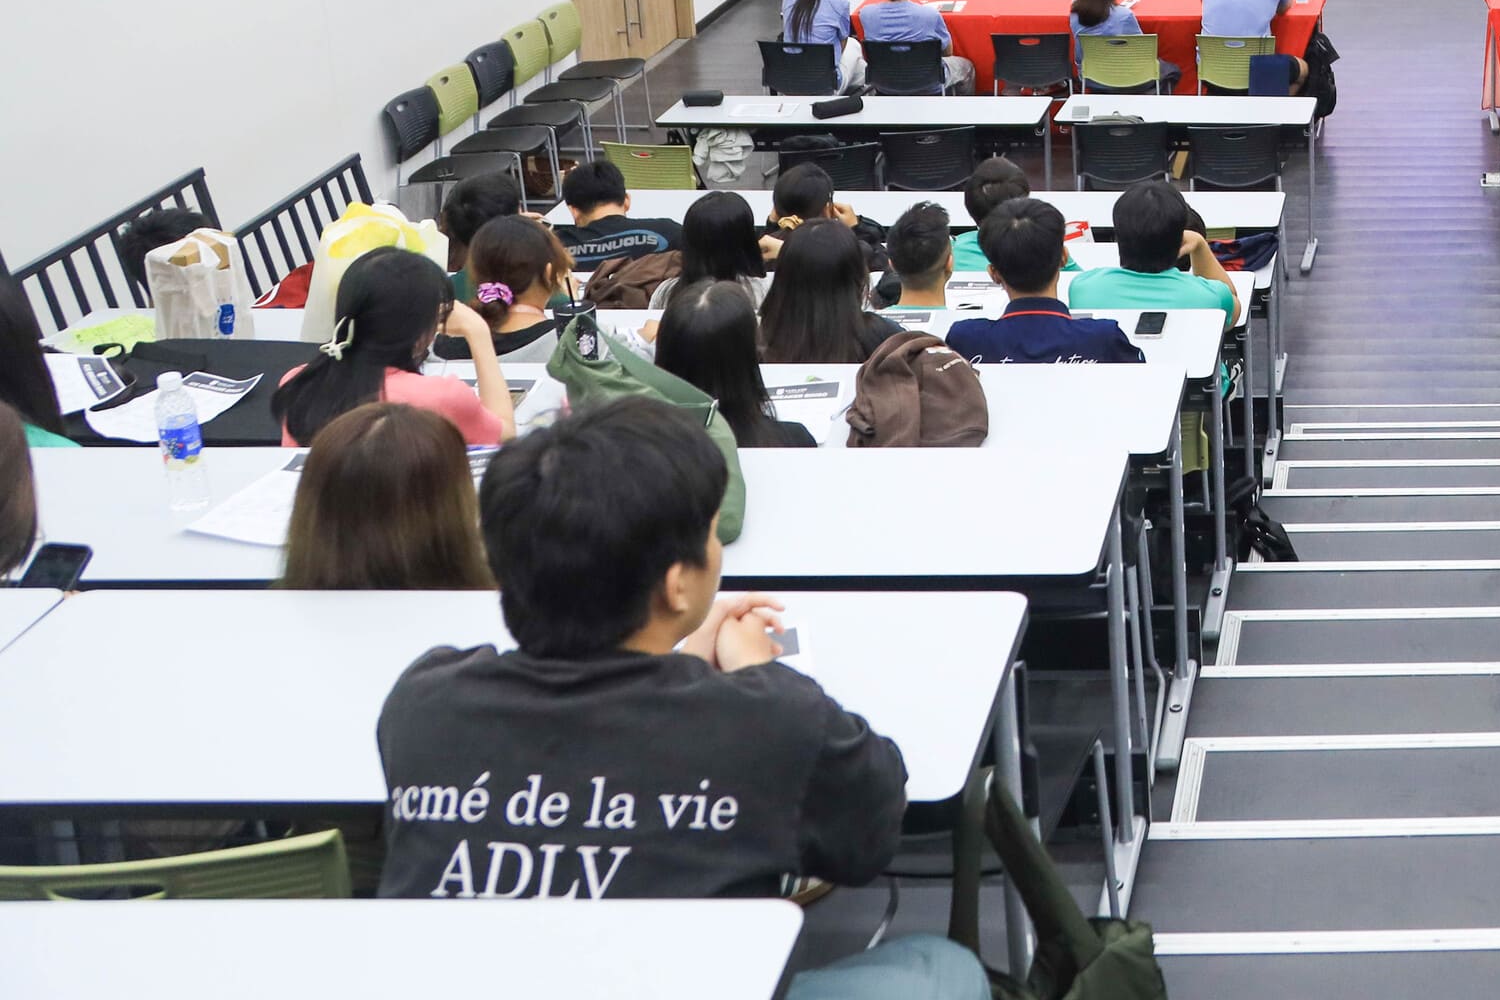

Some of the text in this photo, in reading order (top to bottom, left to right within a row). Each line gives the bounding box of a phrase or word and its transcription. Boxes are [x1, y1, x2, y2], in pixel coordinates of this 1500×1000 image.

[565, 235, 657, 256] ONTINUOUS
[505, 774, 570, 827] de
[583, 776, 637, 829] la
[658, 779, 739, 831] vie
[430, 839, 632, 899] ADLV
